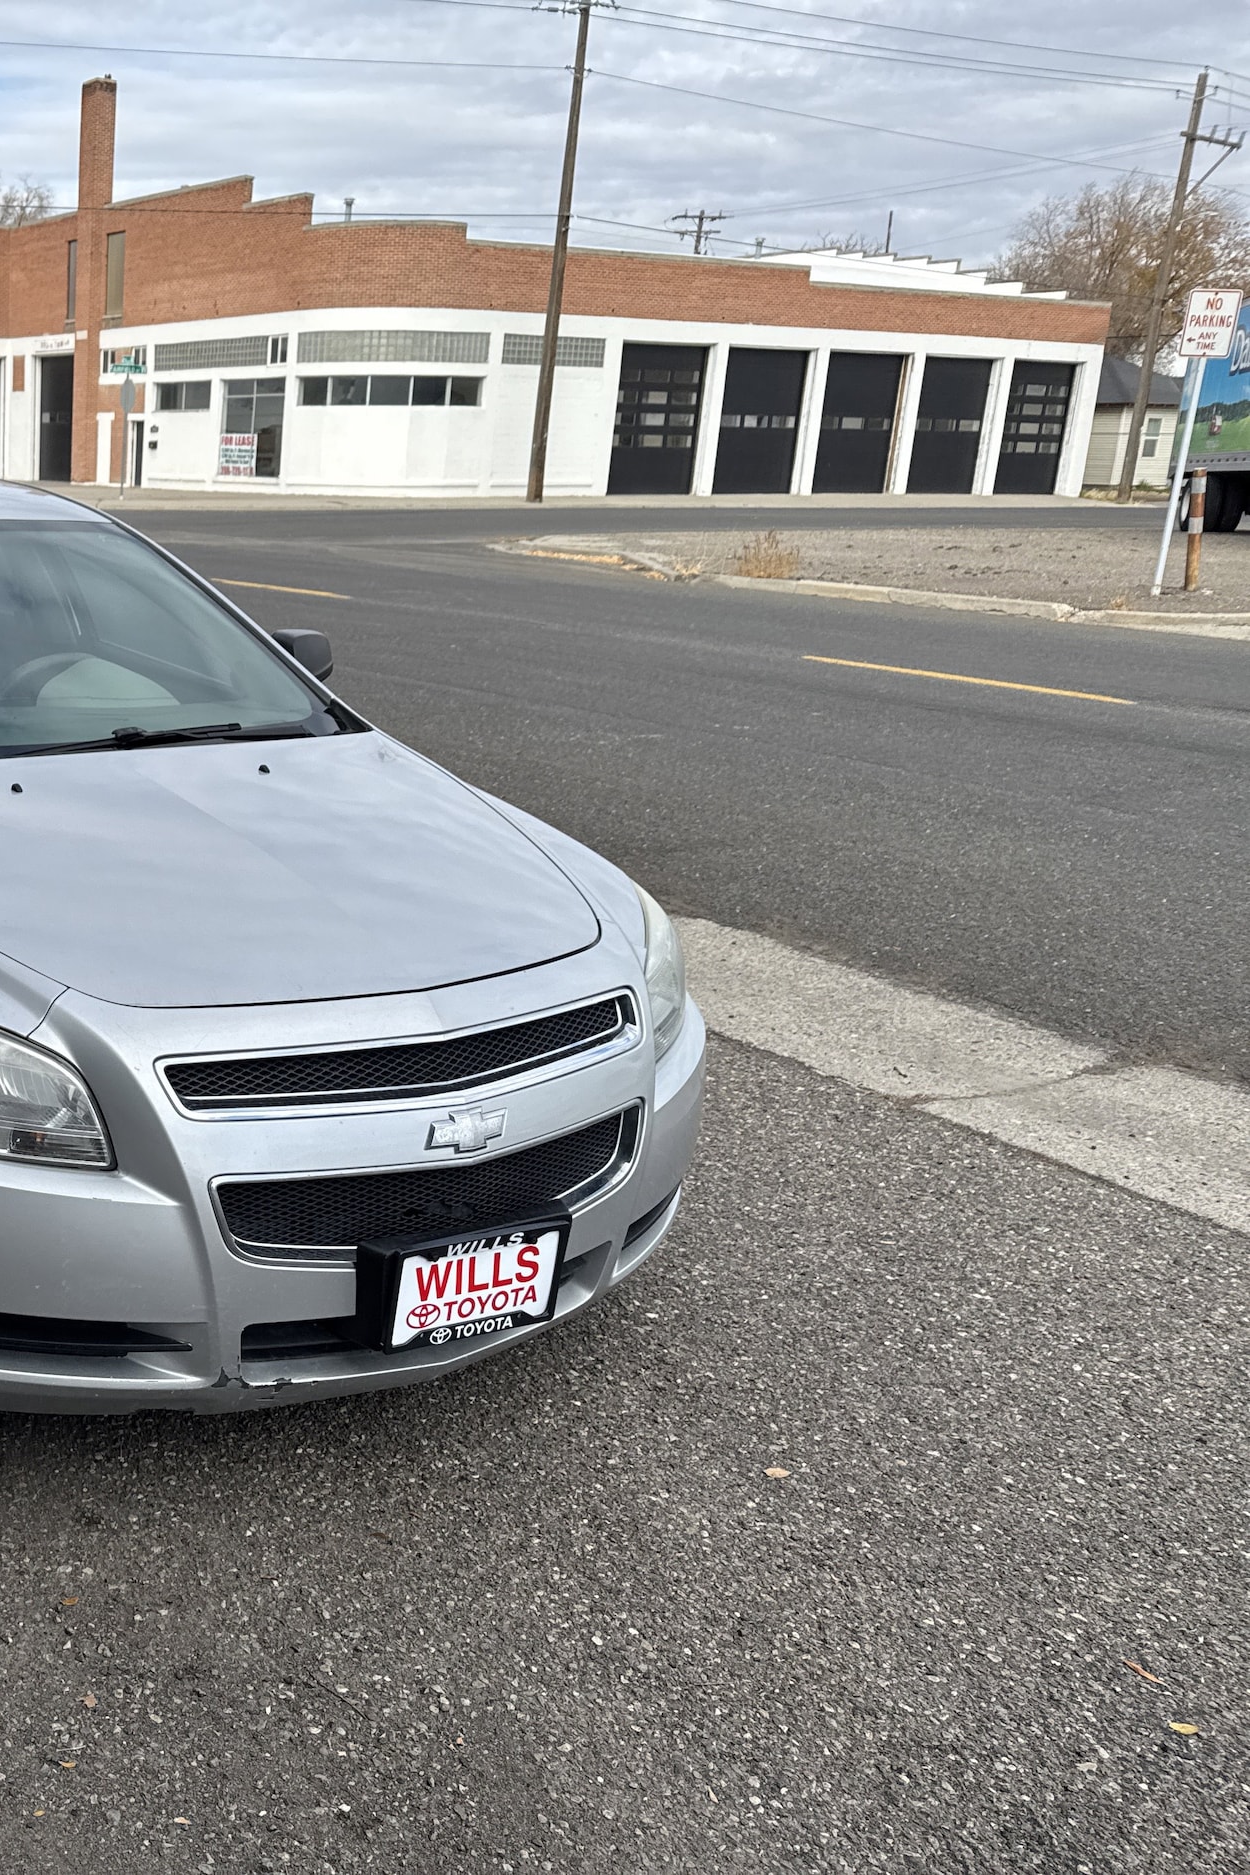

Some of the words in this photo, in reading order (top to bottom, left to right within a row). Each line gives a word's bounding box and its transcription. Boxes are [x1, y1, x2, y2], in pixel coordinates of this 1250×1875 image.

[1206, 298, 1223, 311] NO
[1189, 315, 1233, 328] PARKING
[1198, 332, 1218, 341] ANY
[1196, 342, 1216, 351] TIME
[222, 436, 233, 446] FOR
[235, 436, 254, 446] LEASE
[447, 1232, 525, 1258] WILLS
[415, 1245, 539, 1302] WILLS
[444, 1285, 537, 1321] TOYOTA
[455, 1316, 513, 1339] TOYOTA
